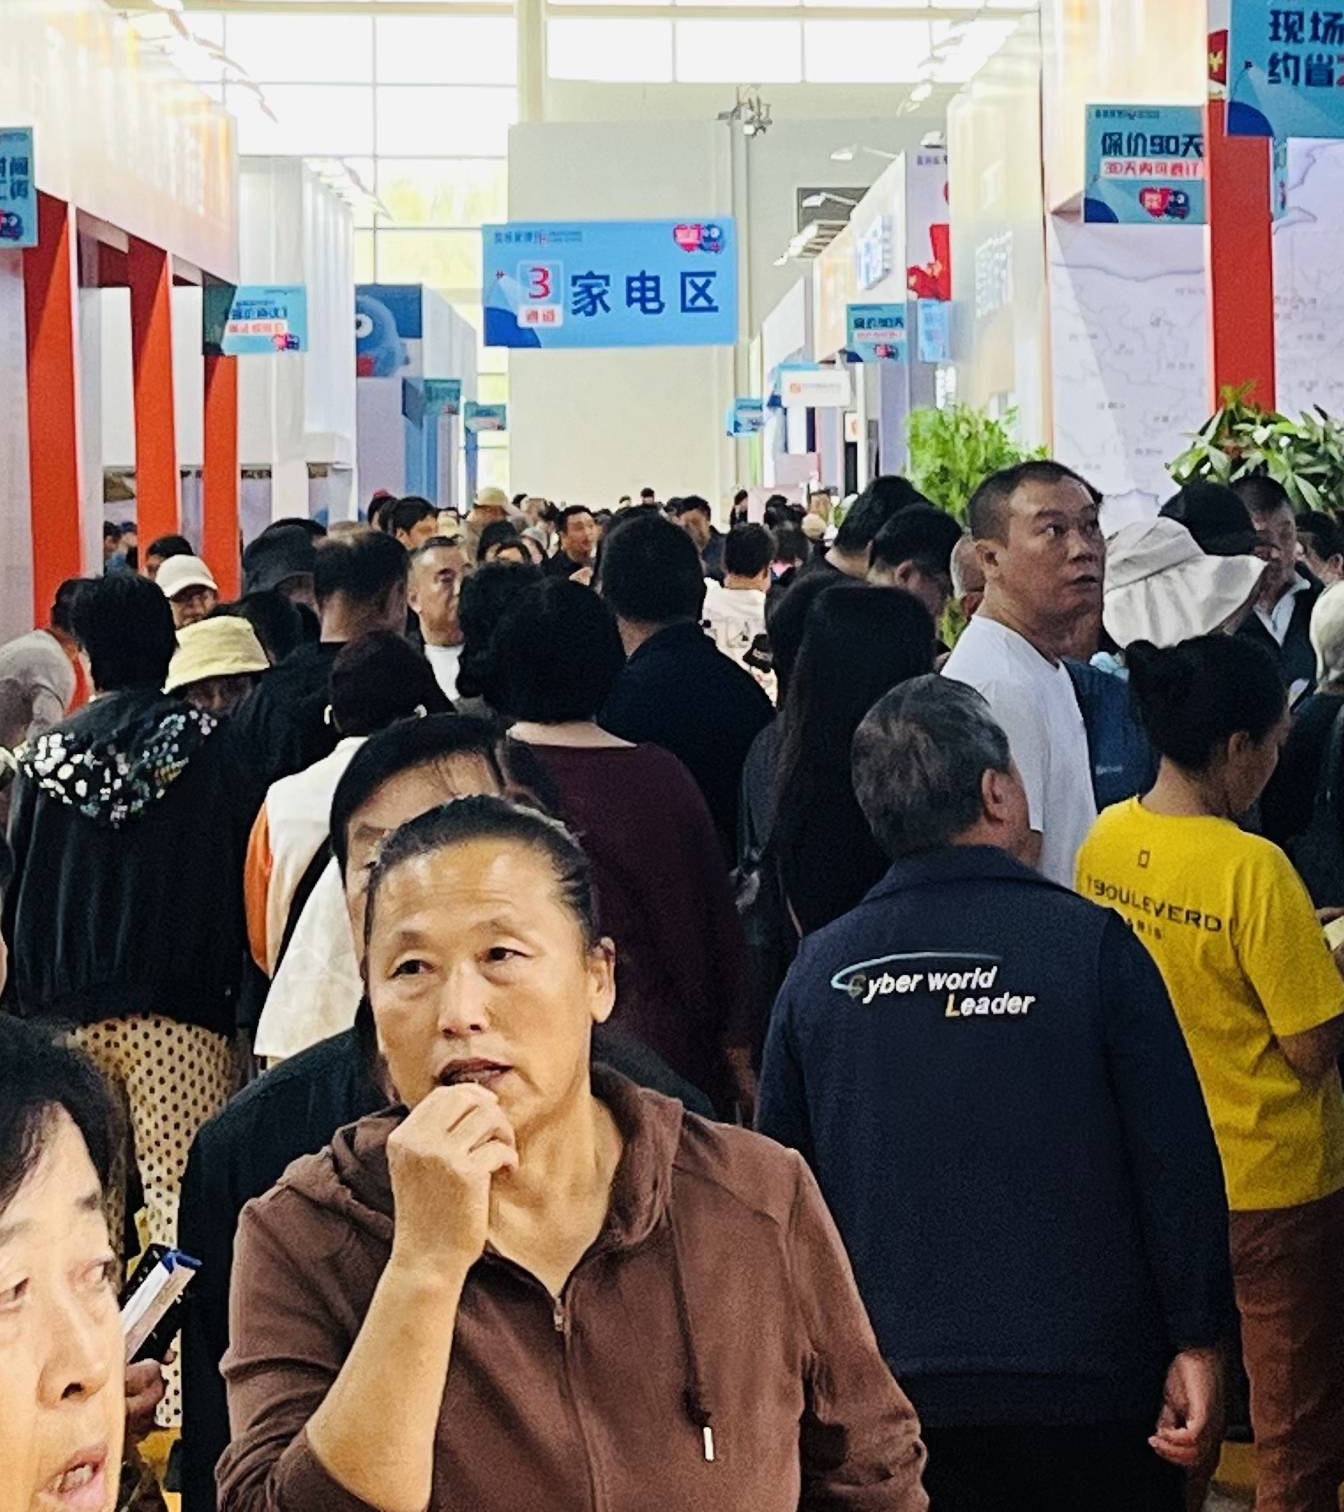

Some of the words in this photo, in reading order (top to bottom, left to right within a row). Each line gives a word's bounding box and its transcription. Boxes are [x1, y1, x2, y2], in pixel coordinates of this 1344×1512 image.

[1101, 132, 1203, 157] 保价90天
[527, 266, 552, 300] 3
[570, 269, 719, 317] 家电区
[847, 972, 924, 1004] Cyber
[927, 965, 998, 992] world
[945, 991, 1036, 1017] Leader
